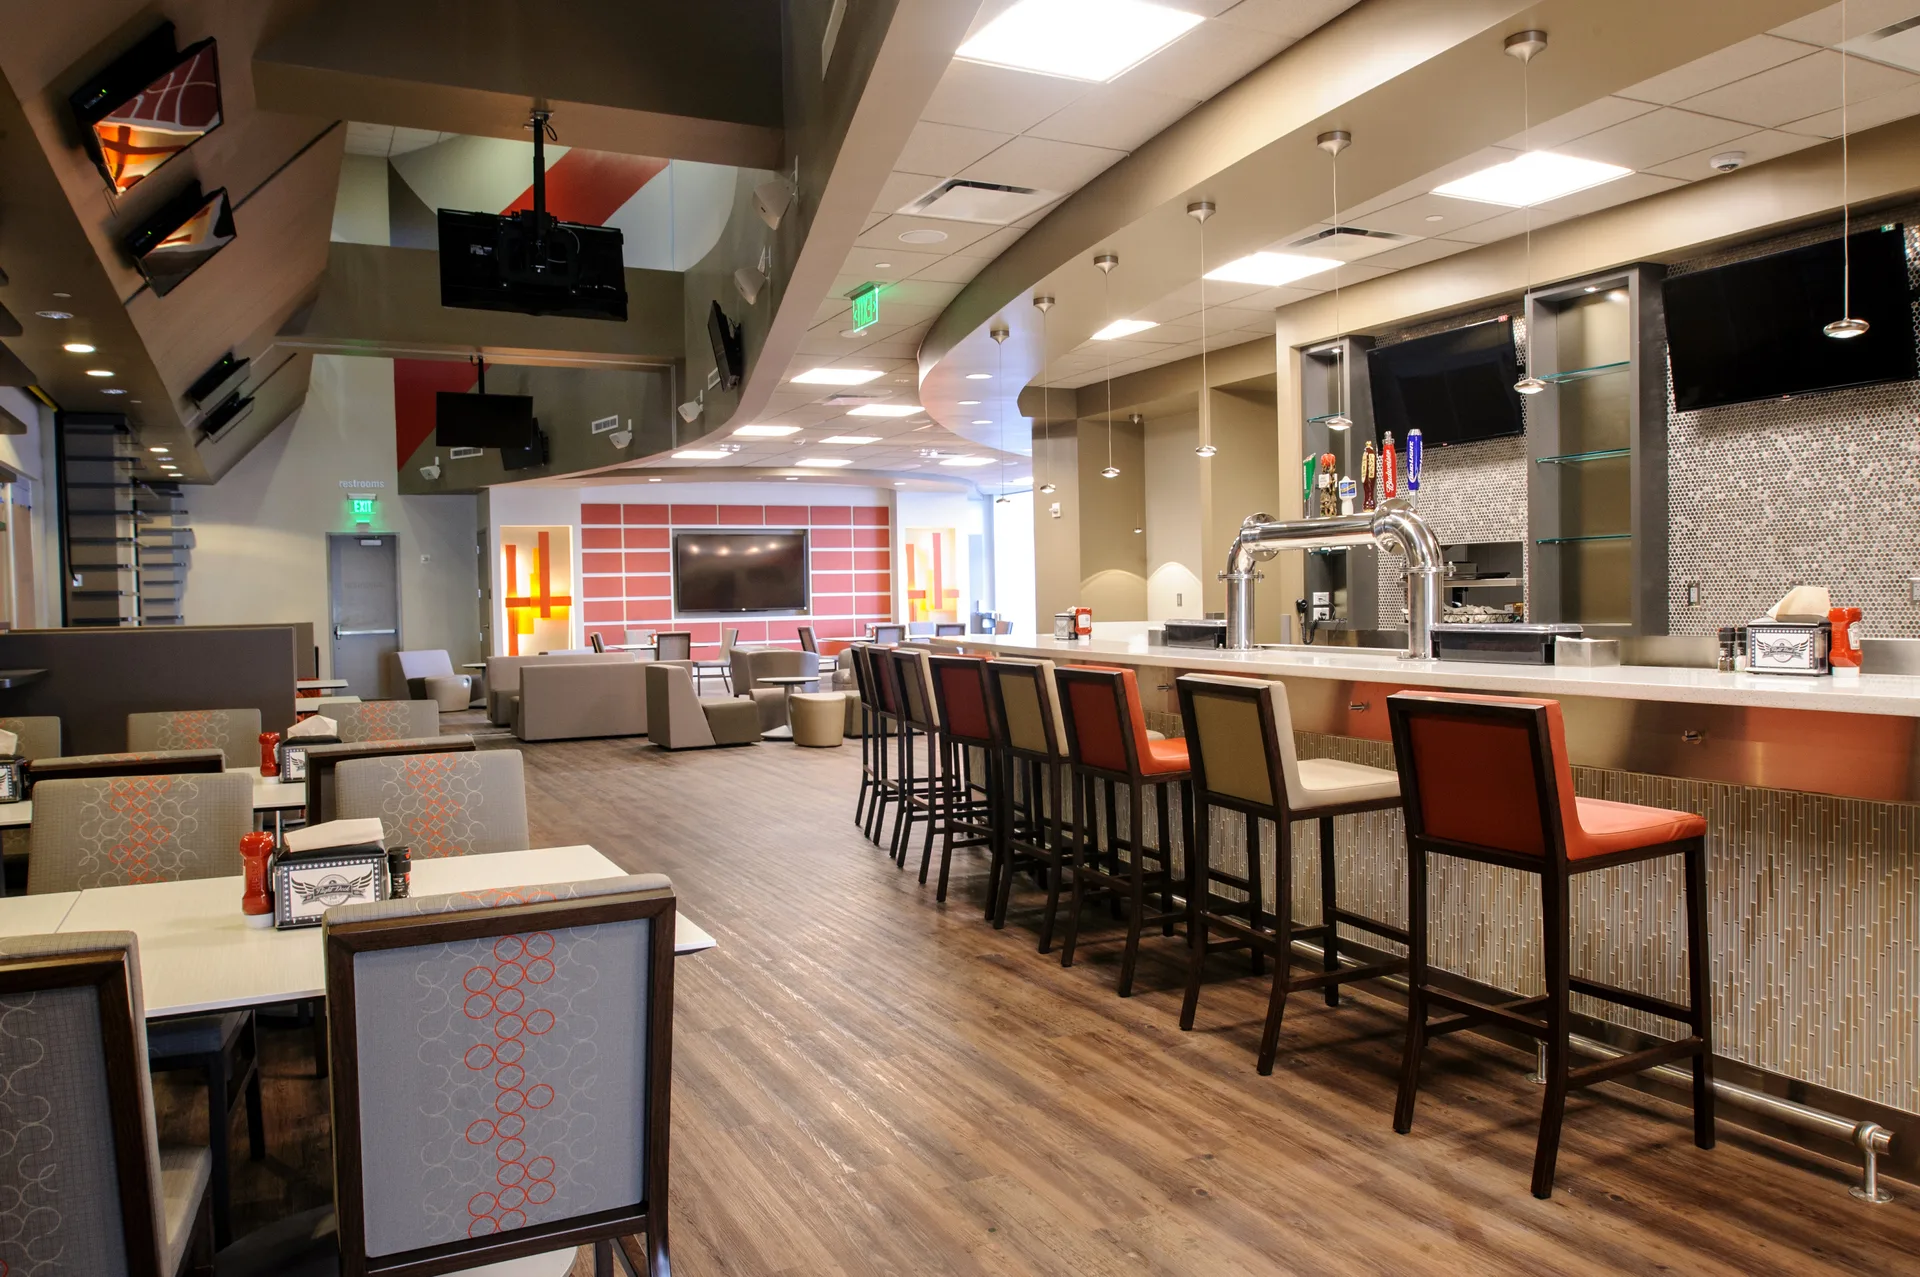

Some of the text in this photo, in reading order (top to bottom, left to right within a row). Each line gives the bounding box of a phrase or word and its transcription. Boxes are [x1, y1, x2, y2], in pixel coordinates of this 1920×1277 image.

[1384, 449, 1395, 493] Budweiser
[339, 479, 385, 488] restrooms
[353, 499, 373, 513] EXIT
